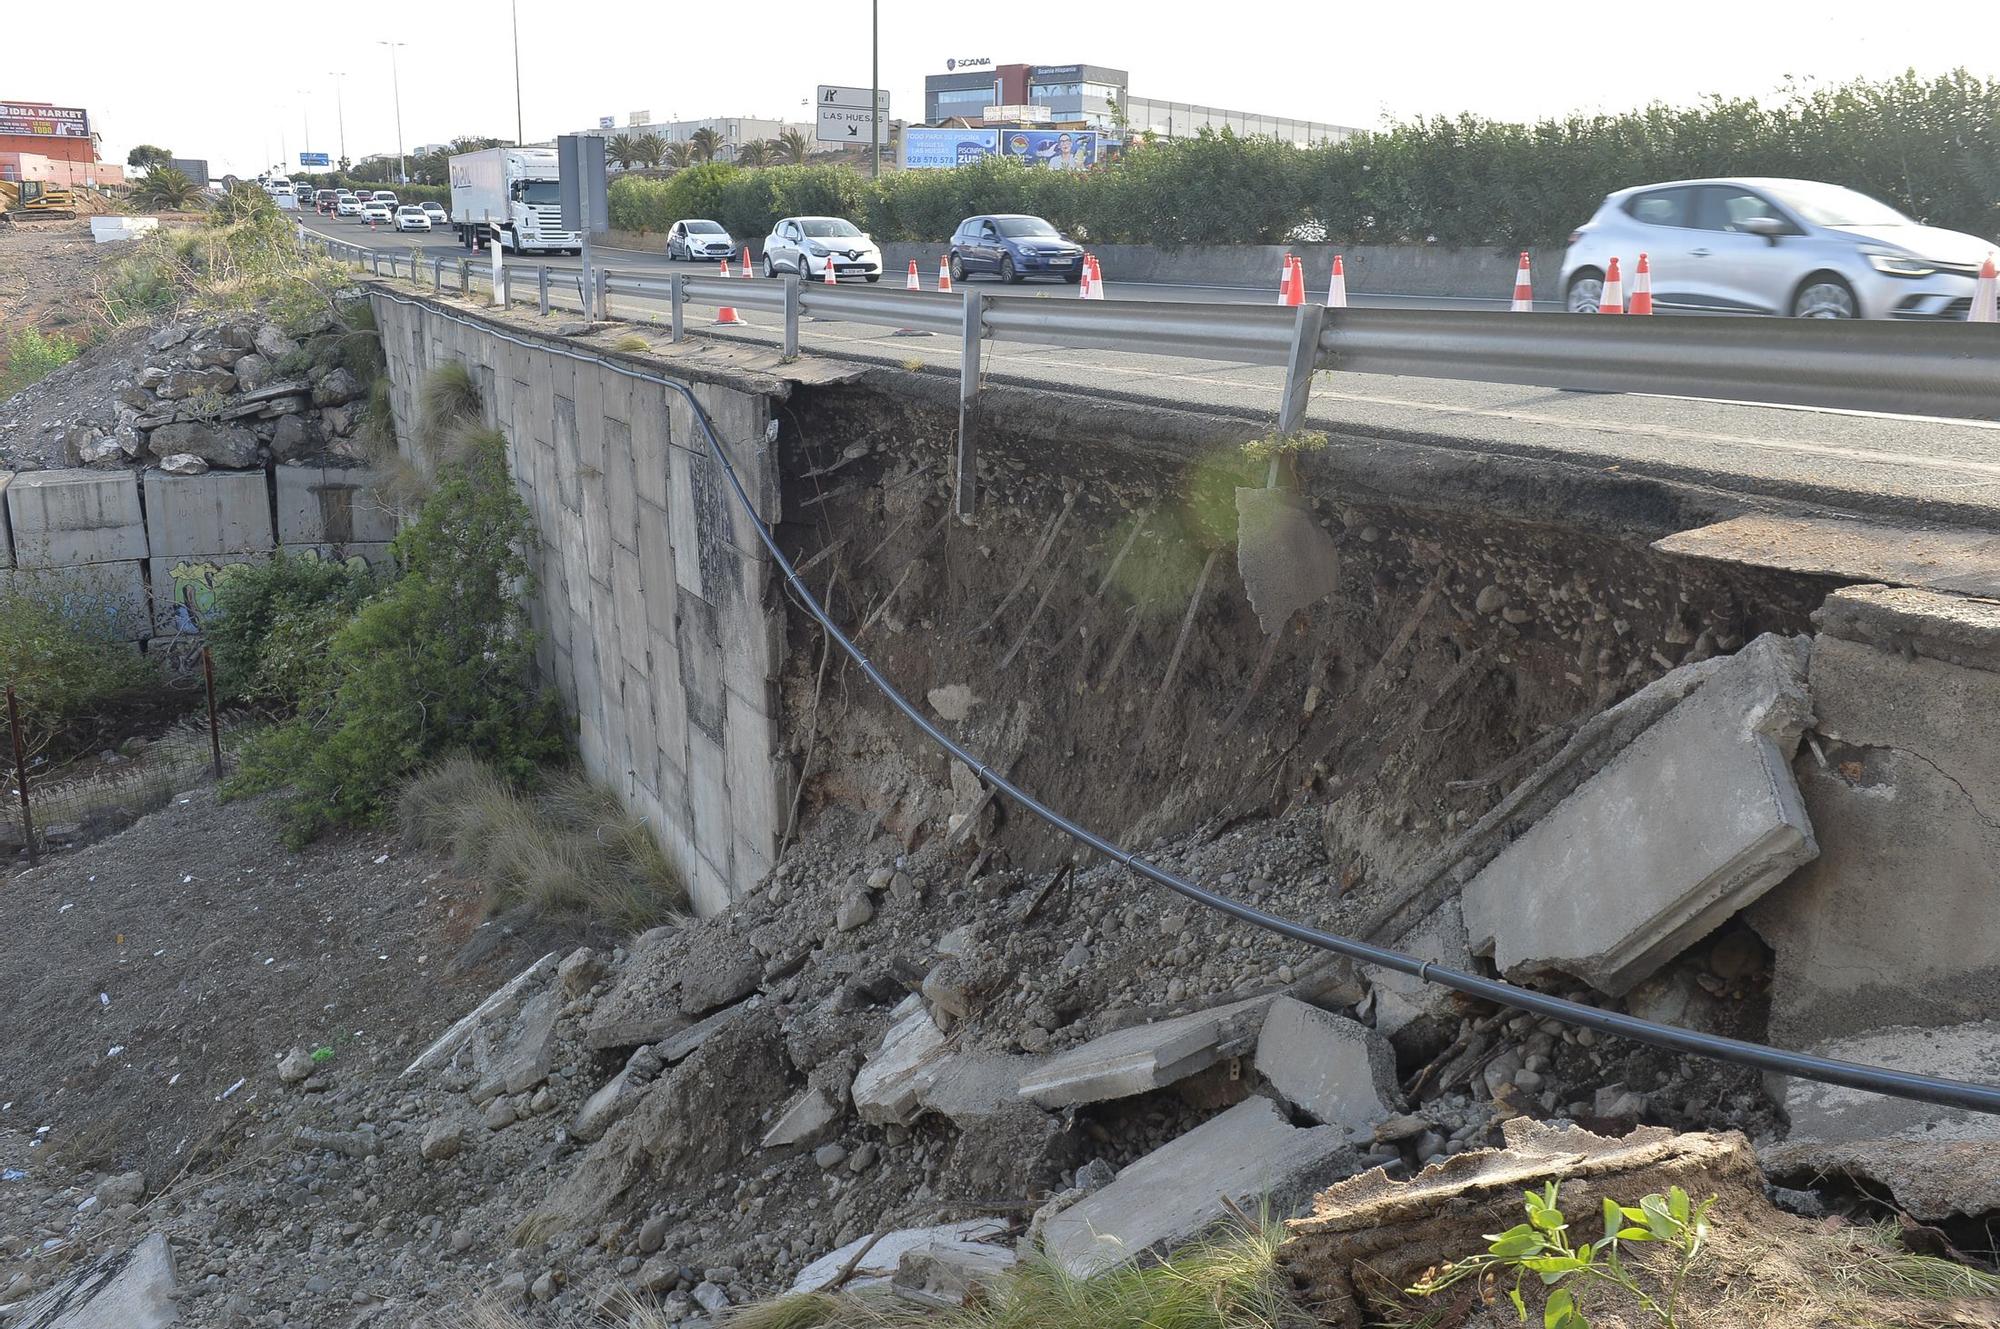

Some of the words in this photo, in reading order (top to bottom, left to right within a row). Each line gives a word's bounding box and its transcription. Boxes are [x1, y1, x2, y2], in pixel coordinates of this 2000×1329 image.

[958, 58, 991, 67] SCANIA
[9, 108, 35, 116] IDEA
[38, 109, 82, 118] MARKET
[823, 112, 842, 121] LAS
[846, 113, 883, 123] HUESS
[34, 126, 53, 134] TODO
[940, 156, 954, 164] 578
